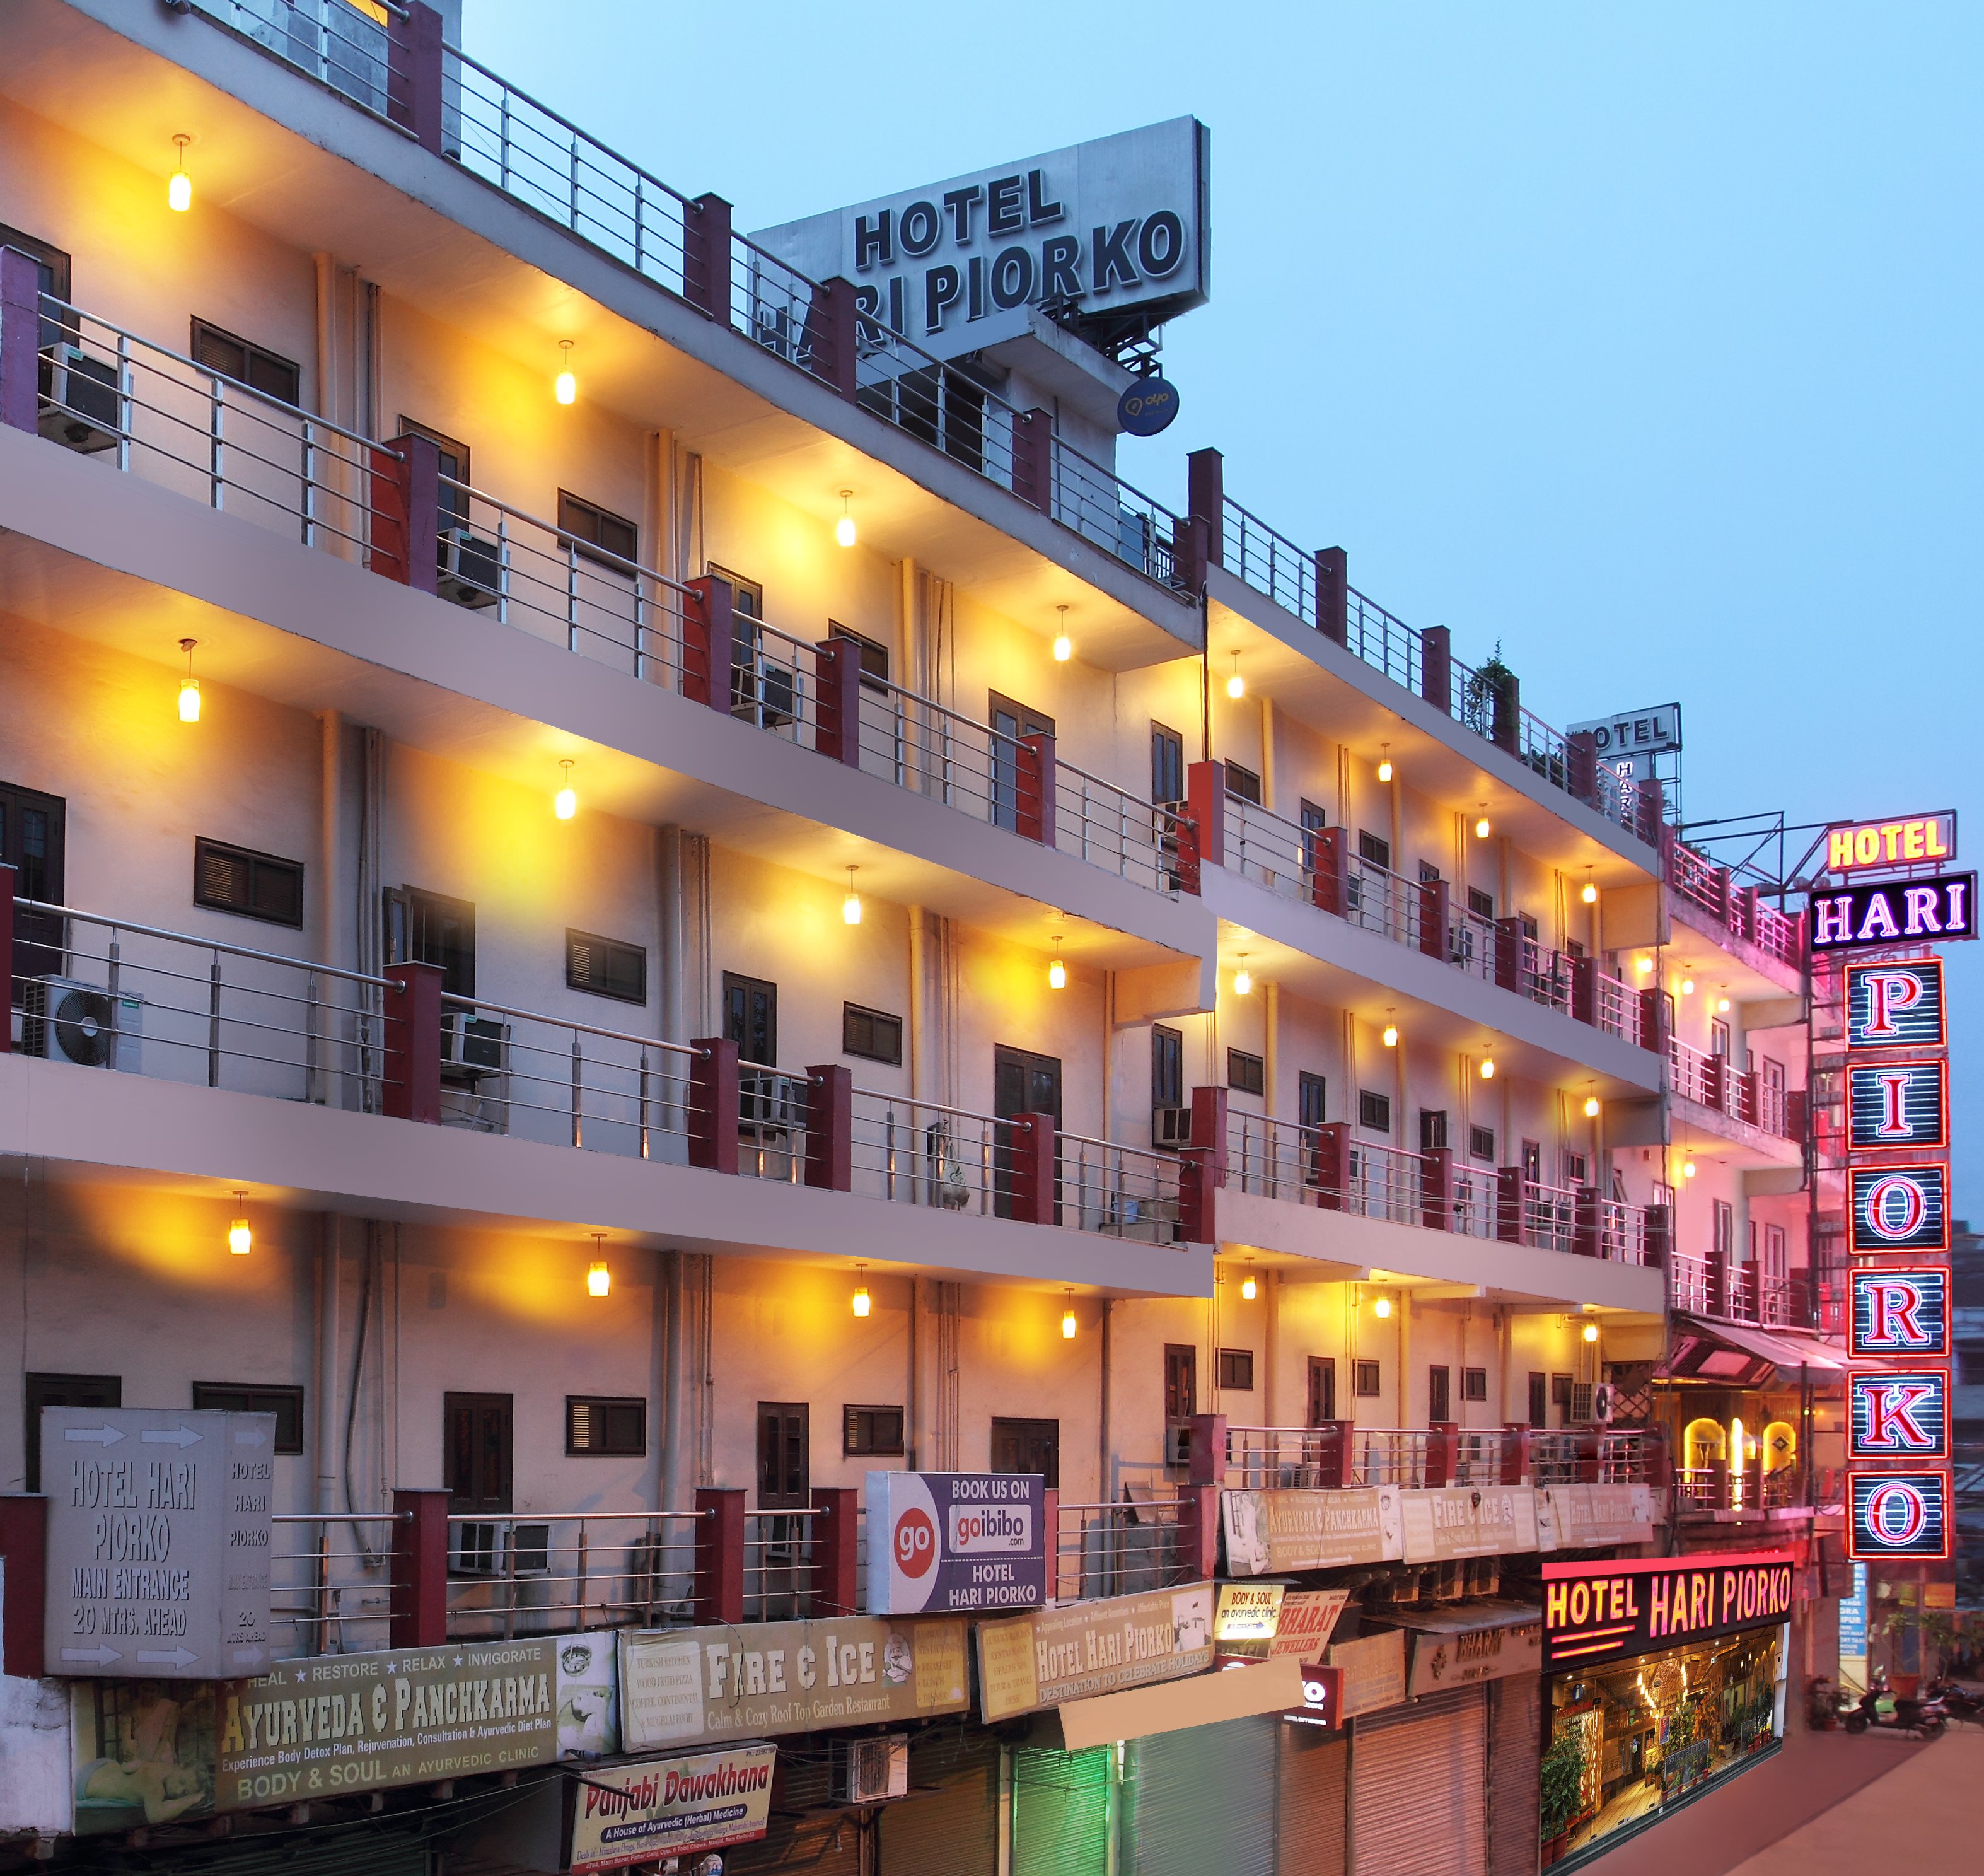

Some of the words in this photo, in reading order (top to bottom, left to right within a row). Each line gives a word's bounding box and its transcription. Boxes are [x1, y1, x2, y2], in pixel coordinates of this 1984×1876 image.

[854, 168, 1065, 272] HOTEL
[760, 274, 908, 362] HRI
[925, 210, 1186, 336] PIORKO
[1583, 716, 1669, 750] OTEL
[1830, 819, 1947, 868] HOTEL
[1813, 883, 1966, 943] HARI
[71, 1460, 137, 1508] HOTEL
[147, 1462, 197, 1510] HARI
[231, 1462, 270, 1480] HOTEL
[234, 1495, 267, 1512] HARI
[952, 1480, 989, 1499] BOOK
[992, 1480, 1007, 1499] US
[1011, 1481, 1030, 1499] ON
[958, 1510, 1024, 1546] goibibo
[1268, 1505, 1316, 1533] AYURVEDA
[1324, 1505, 1379, 1531] PANCHKARMA
[1432, 1495, 1465, 1529] FIRE
[93, 1513, 170, 1563] PIORKO
[229, 1530, 269, 1546] PIORKO
[900, 1525, 929, 1561] go
[1277, 1545, 1297, 1558] BODY
[72, 1568, 108, 1599] MAIN
[113, 1568, 190, 1602] ENTRANCE
[973, 1564, 1015, 1582] HOTEL
[949, 1588, 982, 1607] HARI
[986, 1585, 1037, 1604] PIORKO
[1221, 1609, 1229, 1619] an
[1230, 1606, 1260, 1621] ayurvedic
[1231, 1592, 1250, 1605] BODY
[1250, 1593, 1255, 1605] &
[1256, 1592, 1272, 1605] SOUL
[1546, 1578, 1639, 1629] HOTEL
[1649, 1572, 1715, 1638] HARI
[1722, 1566, 1791, 1624] PIORKO
[73, 1605, 96, 1634] 20
[101, 1607, 140, 1636] MTRS.
[144, 1607, 187, 1636] AHEAD
[1277, 1604, 1340, 1636] BHARAT
[1036, 1640, 1084, 1684] HOTEL
[1086, 1629, 1122, 1672] HARI
[1124, 1623, 1175, 1663] PIORKO
[1271, 1638, 1321, 1655] JEWELLERS
[248, 1672, 287, 1689] HEAL
[313, 1662, 379, 1681] RESTORE
[402, 1655, 446, 1672] RELAX
[468, 1648, 542, 1667] INVIGORATE
[707, 1643, 787, 1699] FIRE
[826, 1636, 877, 1687] ICE
[1039, 1676, 1102, 1703] DESTINATION
[1103, 1672, 1117, 1687] TO
[1119, 1660, 1167, 1684] CELEBRATE
[1169, 1650, 1210, 1671] HOLIDAYS
[221, 1692, 366, 1754] AYURVEDA
[395, 1674, 552, 1731] PANCHKARMA
[707, 1710, 733, 1730] Calm
[735, 1708, 743, 1727] &
[746, 1707, 768, 1729] Cozy
[770, 1703, 792, 1723] Roof
[794, 1703, 811, 1724] Top
[813, 1698, 844, 1718] Garden
[846, 1694, 891, 1714] Restaurant
[222, 1754, 276, 1773] Experience
[278, 1749, 301, 1764] Body
[304, 1746, 330, 1761] Detox
[334, 1743, 354, 1756] Plan,
[357, 1735, 415, 1755] Rejuvenation,
[417, 1728, 467, 1745] Consultation
[470, 1727, 475, 1739] &
[477, 1722, 516, 1739] Ayurvedic
[518, 1720, 533, 1732] Diet
[535, 1718, 552, 1730] Plan
[238, 1770, 302, 1802] BODY
[308, 1768, 322, 1790] &
[330, 1760, 386, 1786] SOUL
[392, 1764, 410, 1778] AN
[418, 1753, 492, 1774] AYURVEDIC
[499, 1746, 540, 1762] CLINIC
[585, 1773, 659, 1821] Punjabi
[664, 1763, 769, 1807] Dawakhana
[605, 1829, 612, 1839] A
[613, 1827, 637, 1838] House
[638, 1822, 646, 1833] of
[647, 1817, 683, 1834] Ayurvedic
[684, 1813, 712, 1828] (Herbal)
[713, 1807, 744, 1821] Medicine
